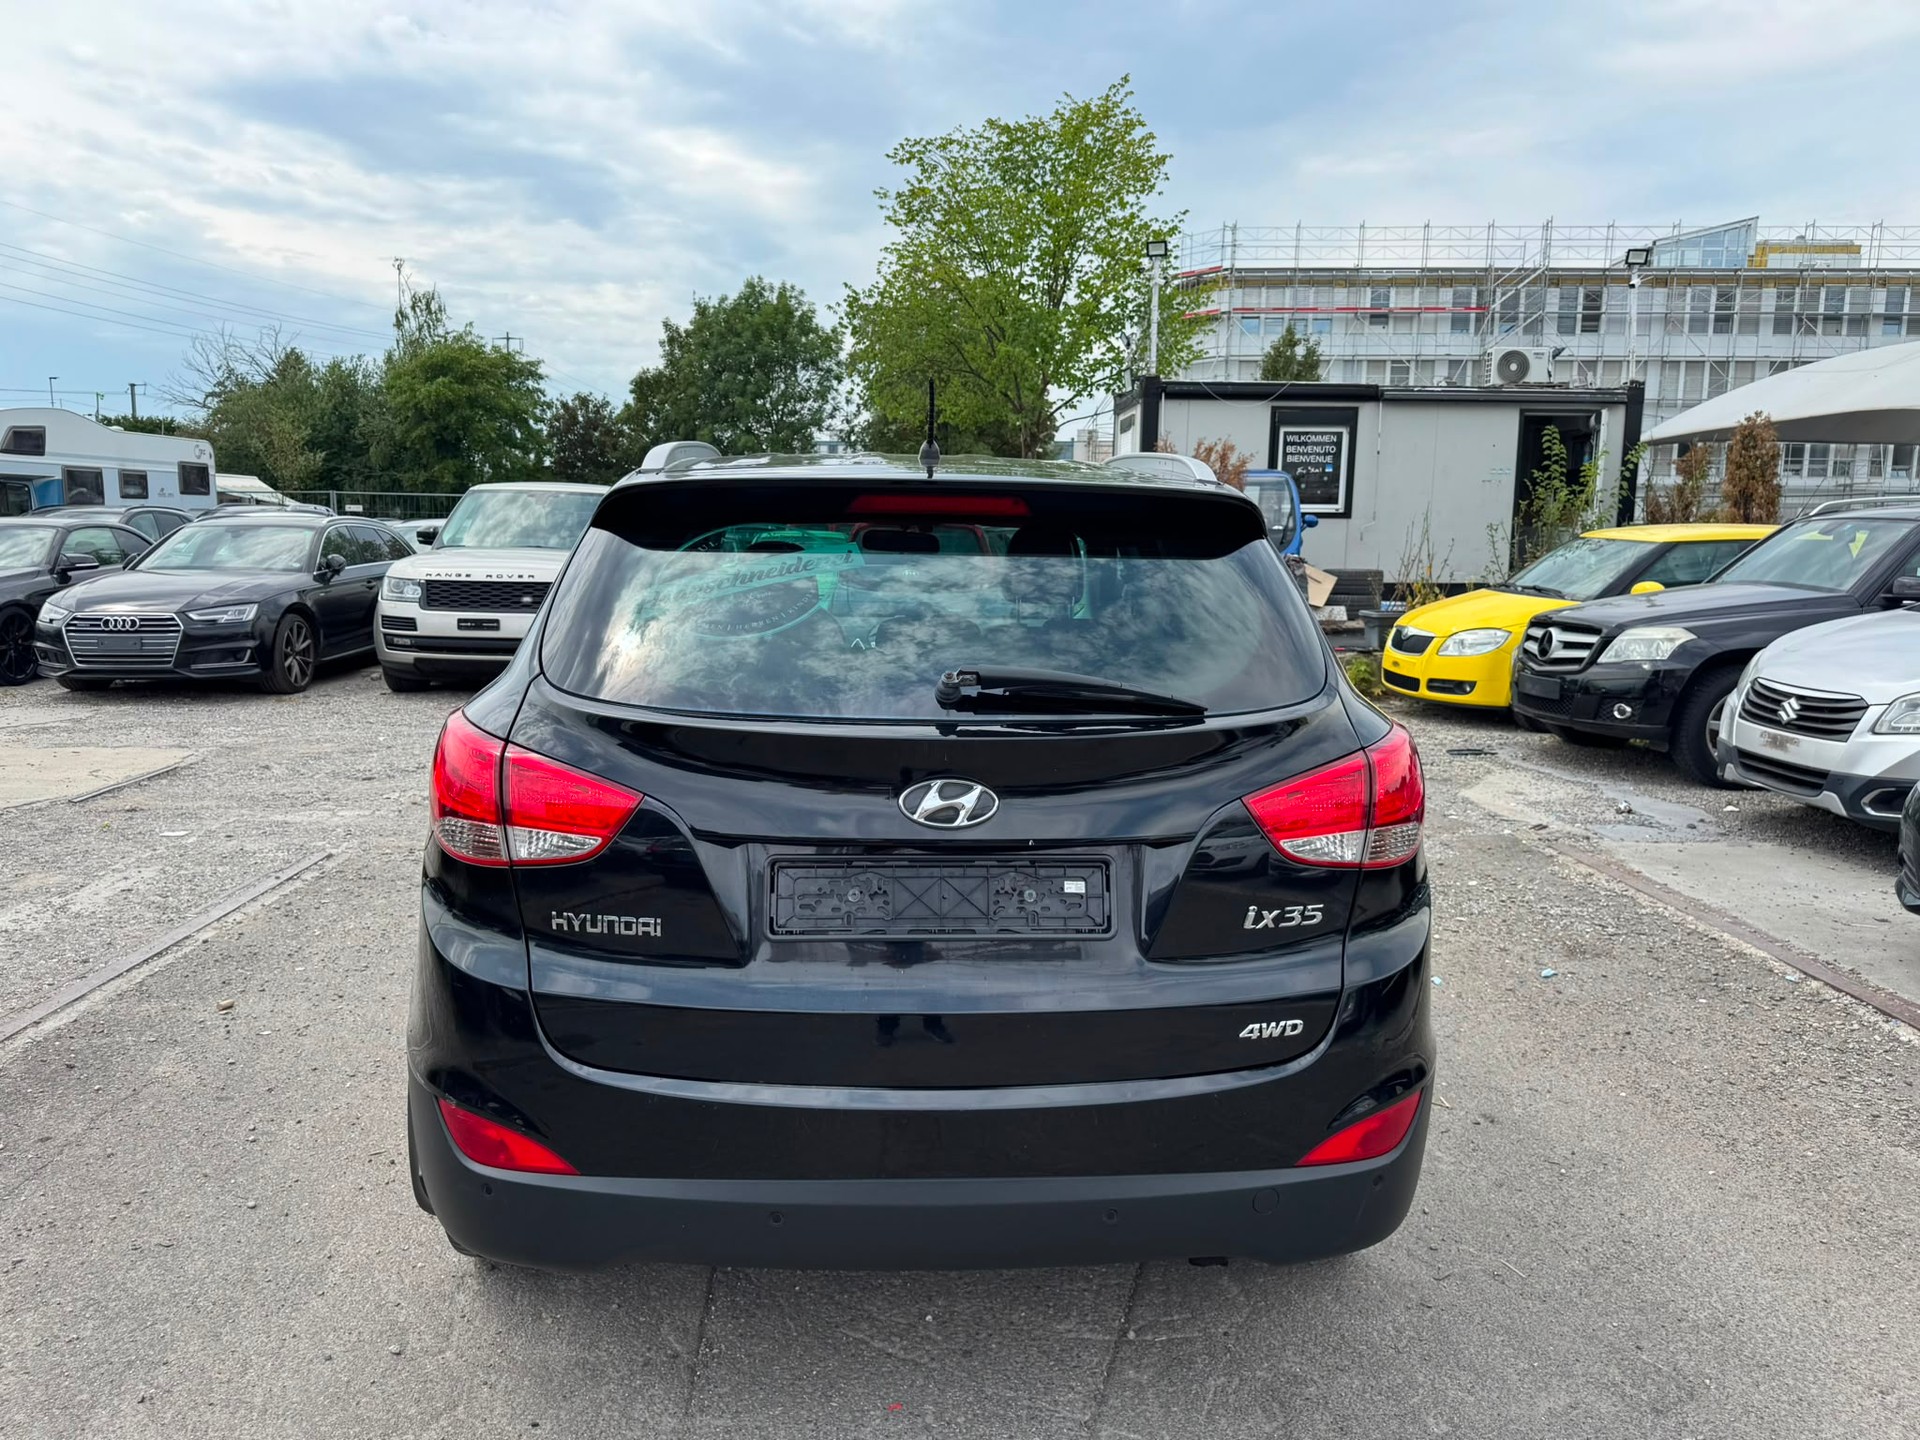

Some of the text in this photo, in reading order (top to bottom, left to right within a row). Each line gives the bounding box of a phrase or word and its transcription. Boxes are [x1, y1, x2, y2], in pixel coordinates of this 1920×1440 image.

[1286, 445, 1337, 453] BENVENUTO
[1286, 455, 1334, 463] BIENVENUE
[551, 911, 662, 937] HYUNDAI
[1243, 904, 1324, 929] ix35
[1239, 1019, 1304, 1039] 4WD
